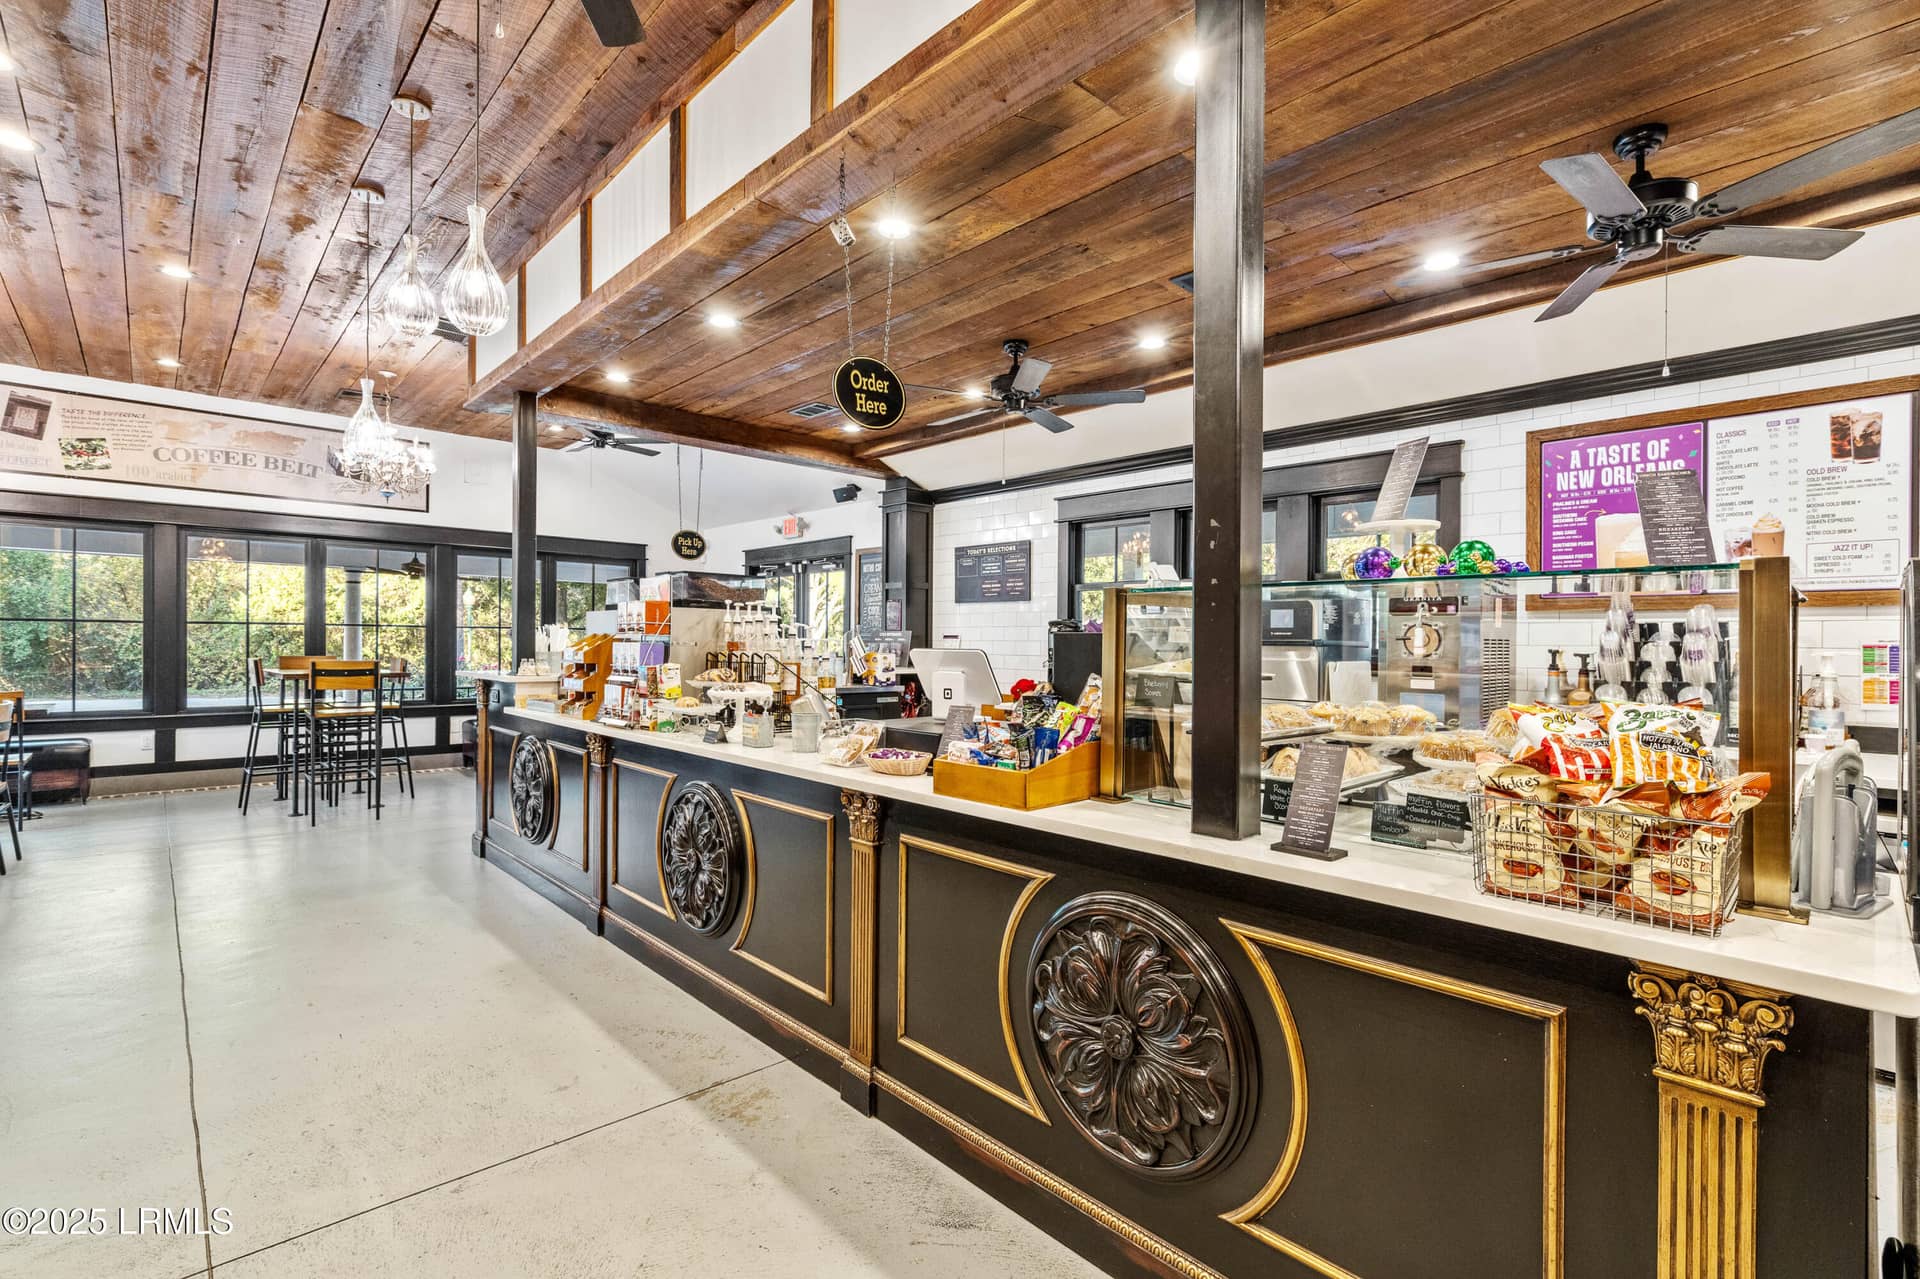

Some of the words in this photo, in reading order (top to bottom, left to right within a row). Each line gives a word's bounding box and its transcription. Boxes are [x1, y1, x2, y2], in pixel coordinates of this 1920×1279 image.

[850, 369, 889, 394] Order
[855, 392, 888, 415] Here
[1716, 429, 1747, 439] CLASSICS
[1570, 449, 1582, 470] A
[1587, 441, 1641, 468] TASTE
[1647, 438, 1670, 461] OF
[152, 446, 257, 468] COFFEE
[264, 455, 324, 479] BELT
[1806, 468, 1826, 476] COLD
[1827, 465, 1848, 474] BREW
[1556, 468, 1595, 492] NEW
[783, 519, 797, 535] EXIT
[678, 537, 692, 546] Pick
[693, 537, 703, 548] Up
[1832, 544, 1850, 552] JAZZ
[1860, 543, 1873, 551] UP!
[681, 546, 697, 555] Here
[987, 545, 1017, 553] SELECTIONS
[1642, 733, 1673, 745] HOTTER
